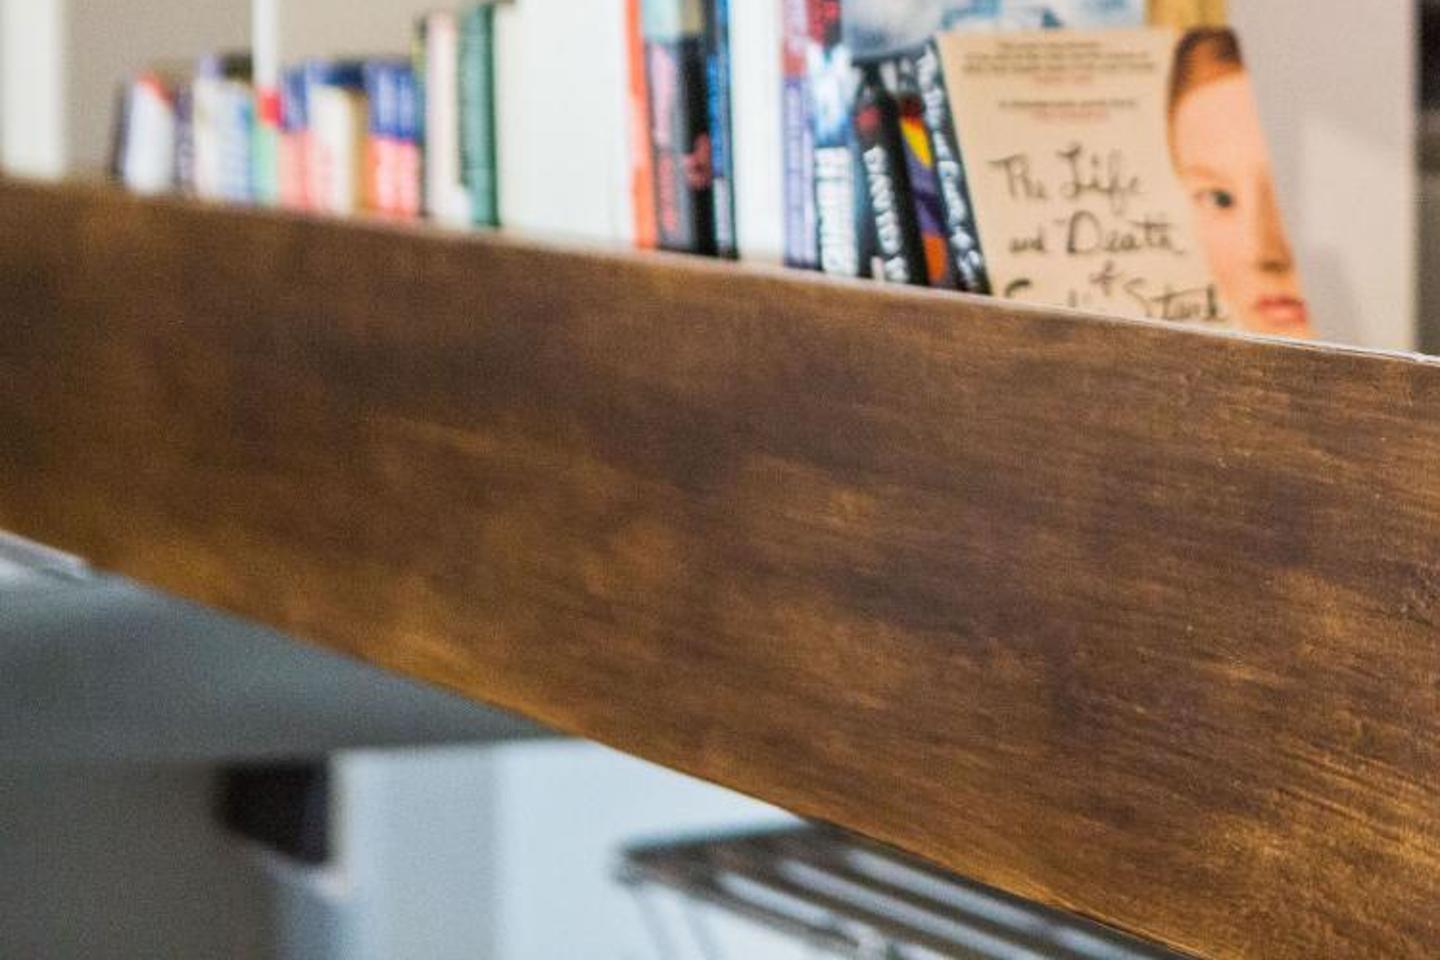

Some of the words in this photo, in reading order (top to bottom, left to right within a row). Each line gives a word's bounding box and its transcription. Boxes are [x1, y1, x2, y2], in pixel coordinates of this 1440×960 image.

[988, 152, 1048, 200] The
[1055, 141, 1139, 216] Life
[1008, 228, 1046, 254] and
[1053, 209, 1186, 256] Death
